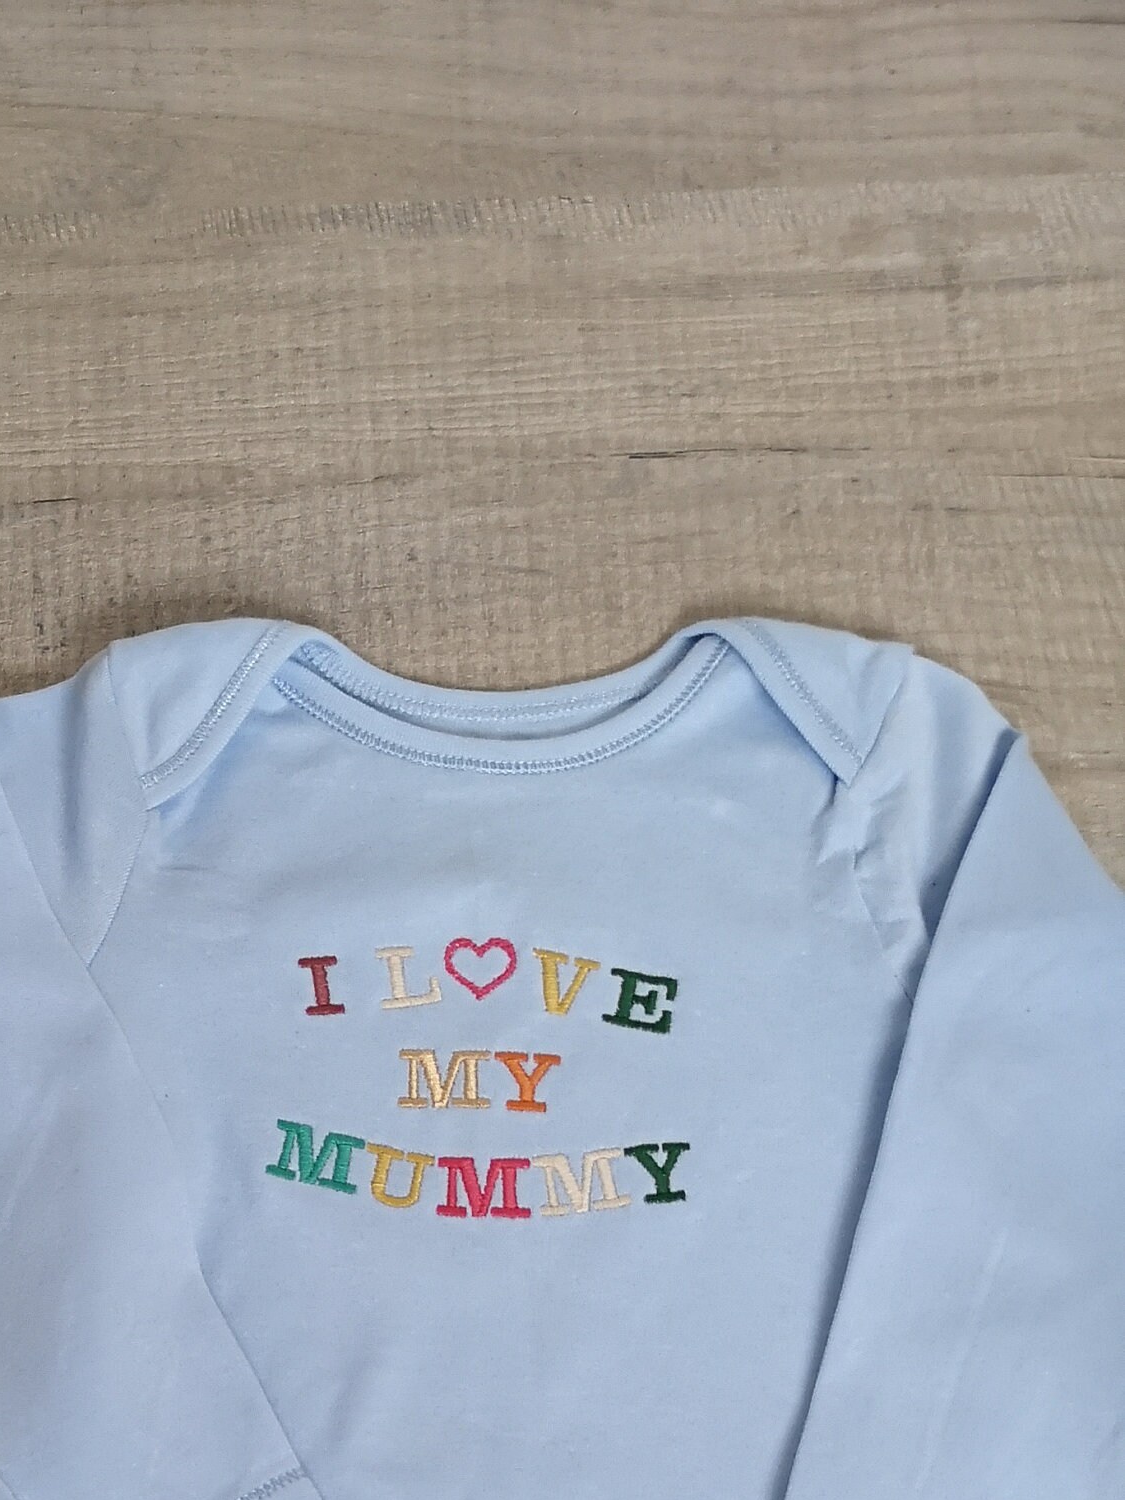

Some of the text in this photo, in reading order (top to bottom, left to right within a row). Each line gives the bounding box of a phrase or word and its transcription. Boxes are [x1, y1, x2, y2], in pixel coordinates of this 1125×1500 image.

[297, 955, 345, 1016] I
[397, 1048, 561, 1112] MY
[265, 1118, 691, 1219] MUMMY
